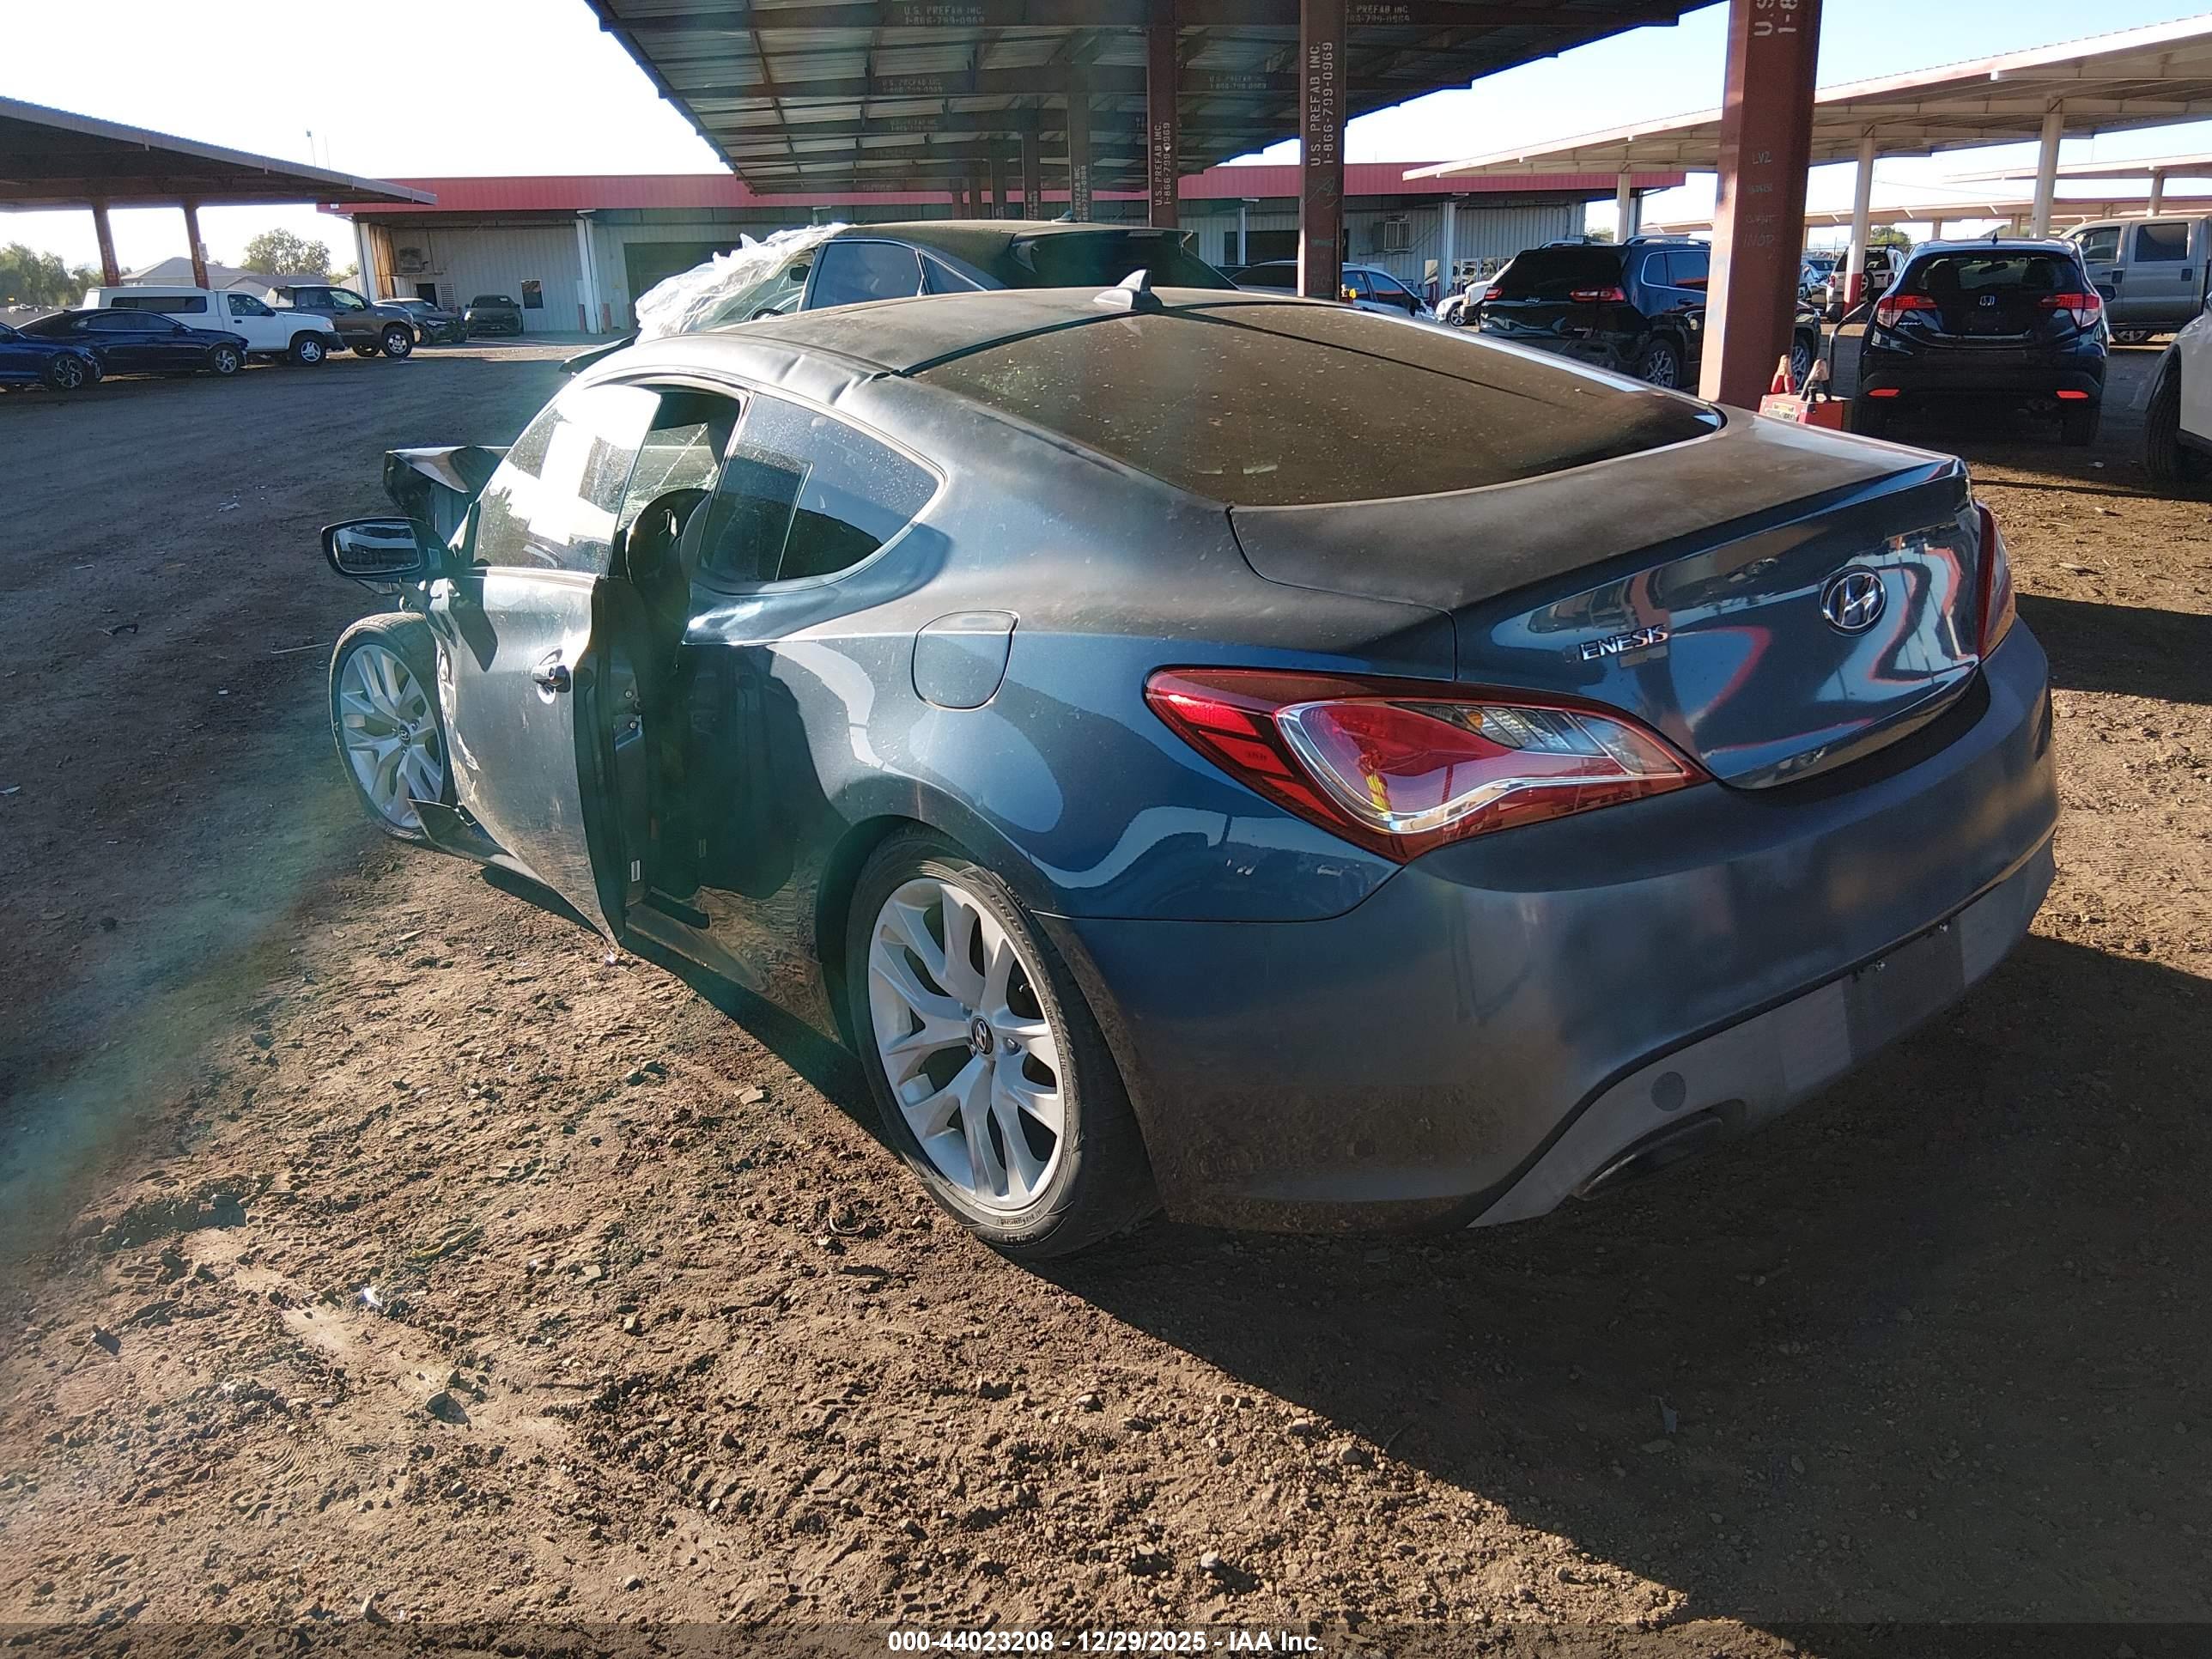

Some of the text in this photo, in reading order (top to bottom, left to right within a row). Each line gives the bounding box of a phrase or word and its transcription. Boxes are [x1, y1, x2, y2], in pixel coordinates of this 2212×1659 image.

[1309, 41, 1322, 167] U.S. PREFAB INC.
[1322, 42, 1334, 164] 1-866-799-0969
[1154, 145, 1163, 183] PREFAB
[1154, 186, 1163, 206] U.S.
